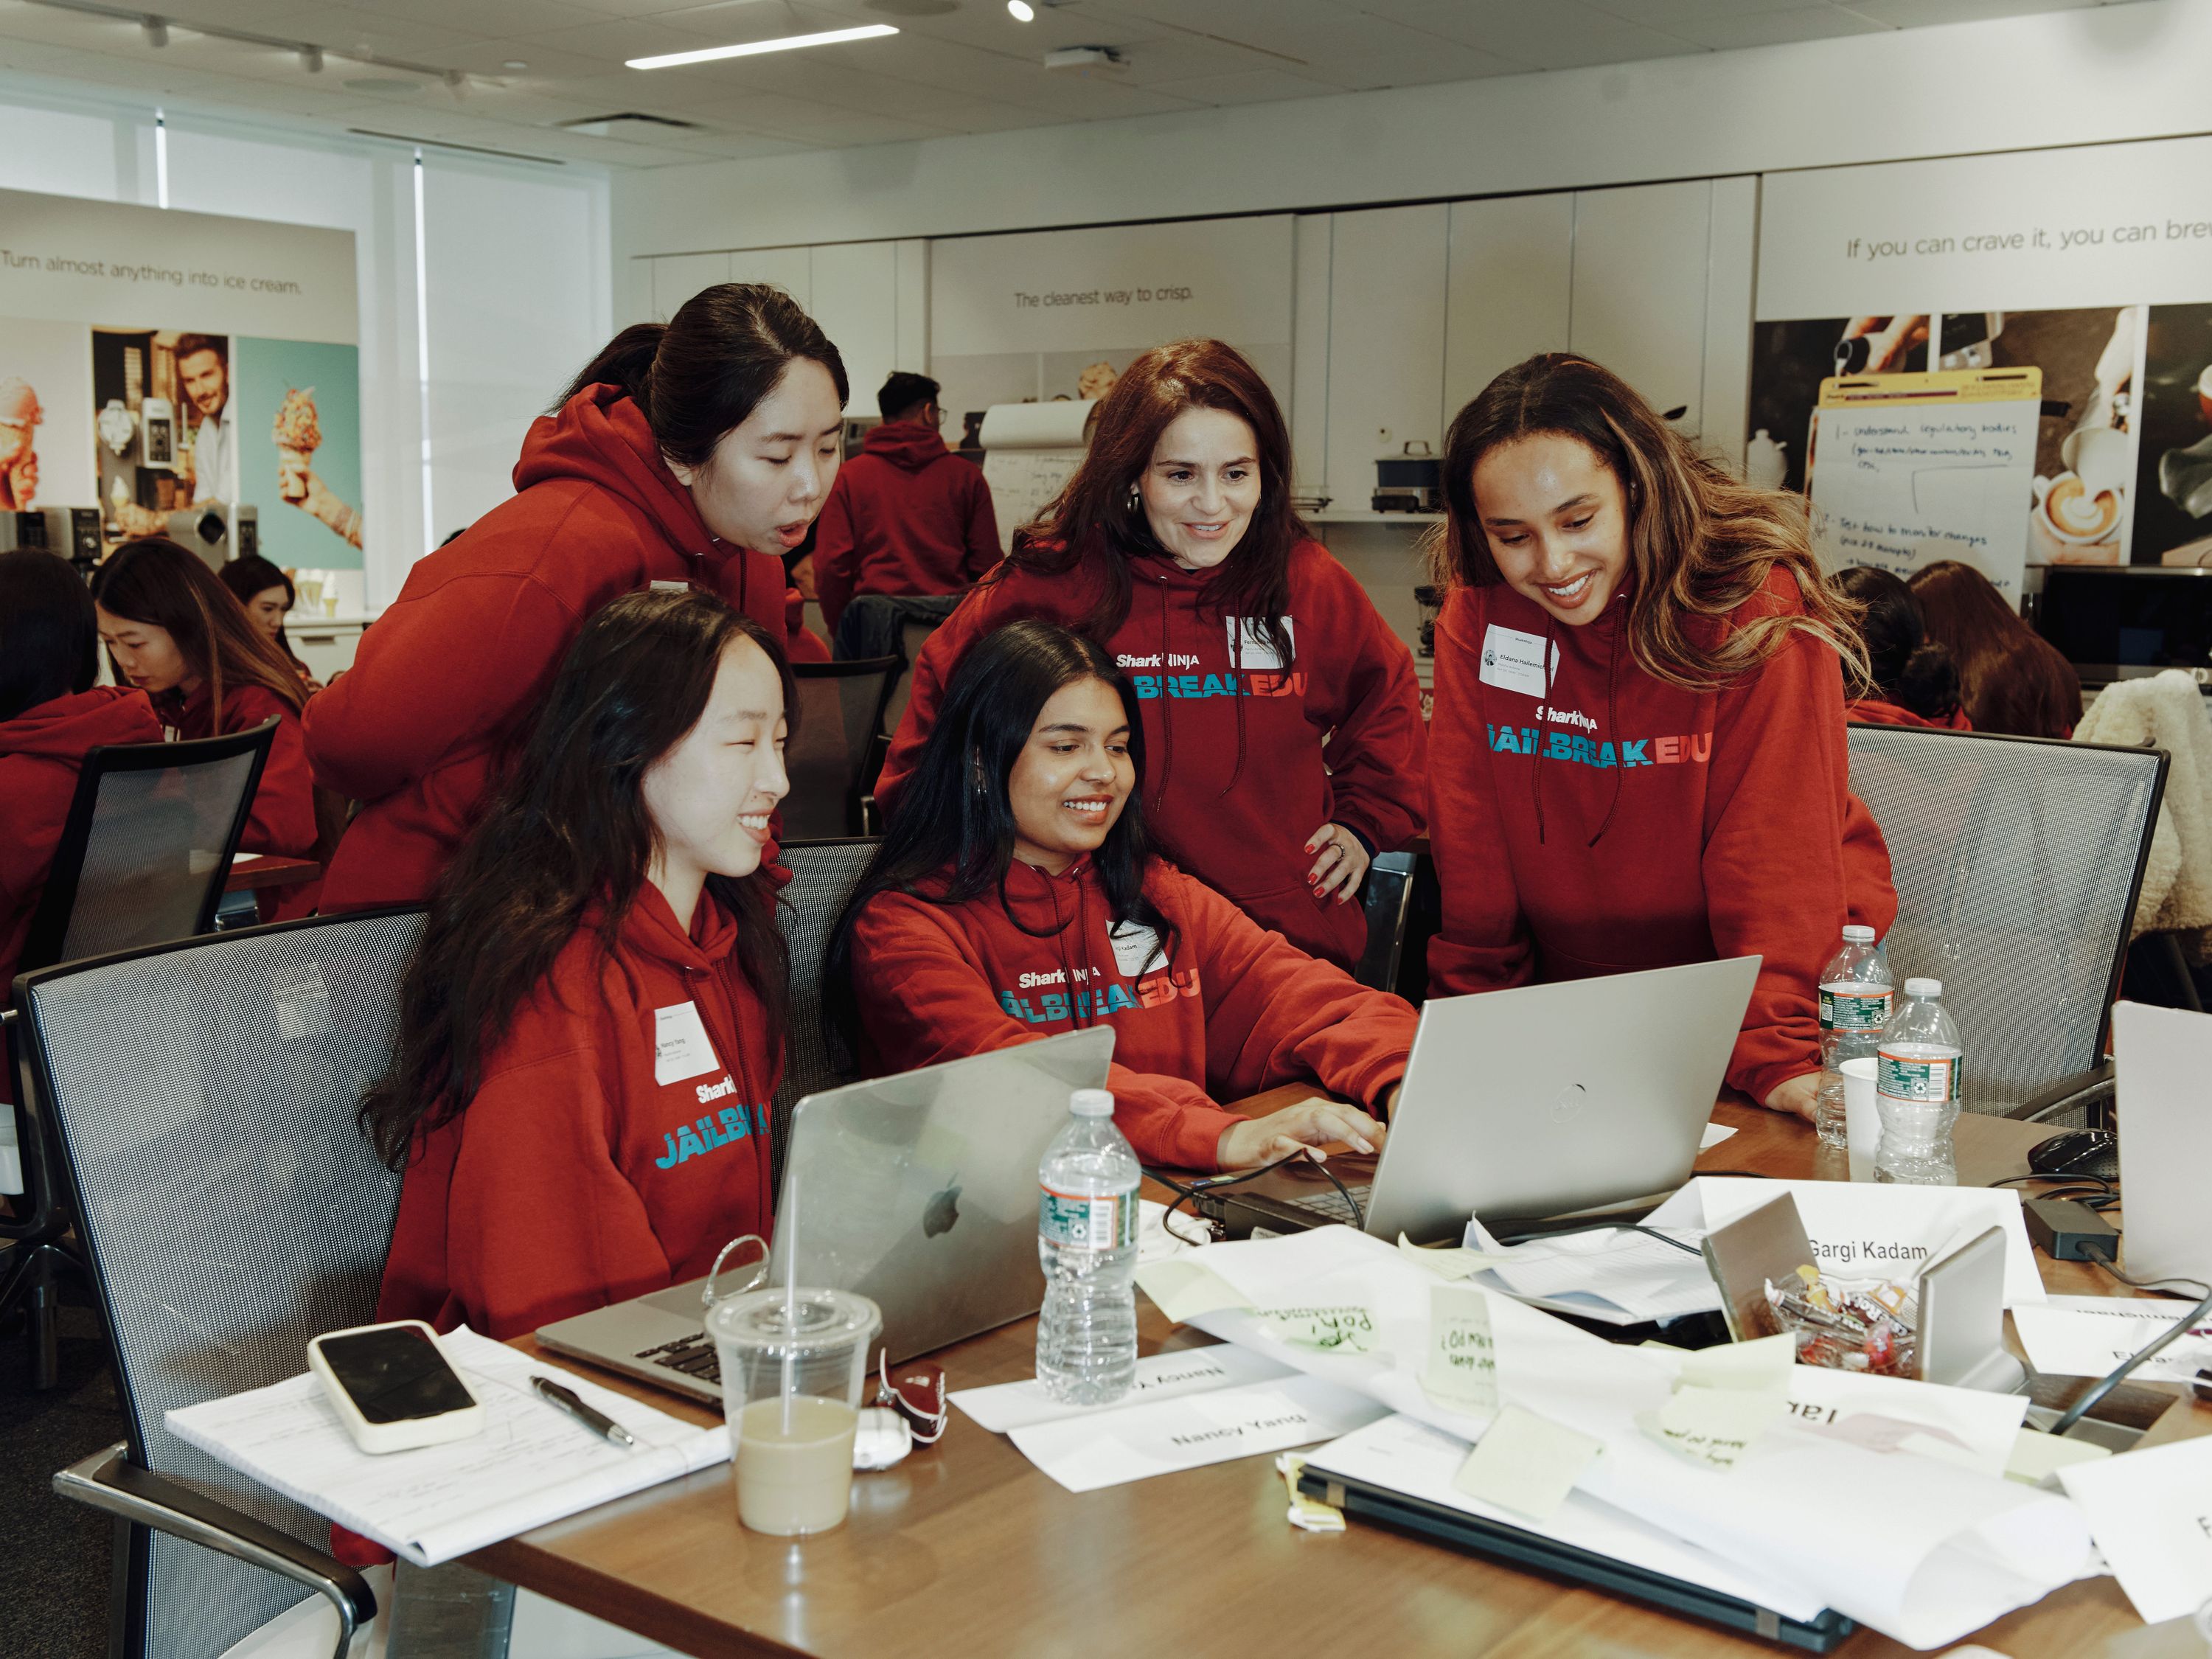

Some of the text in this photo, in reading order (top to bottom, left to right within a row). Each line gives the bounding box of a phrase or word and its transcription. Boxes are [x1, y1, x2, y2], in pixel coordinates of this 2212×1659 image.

[1847, 237, 1861, 258] If
[1868, 240, 1907, 261] you
[1916, 237, 1955, 255] can
[1962, 232, 2025, 252] crave
[2032, 227, 2051, 249] it,
[2059, 228, 2104, 251] you
[2112, 224, 2157, 243] can
[1, 248, 302, 295] Turn almost anything into ice cream.
[1015, 292, 1039, 308] The
[1043, 289, 1100, 307] cleanest
[1104, 290, 1133, 305] way
[1136, 287, 1152, 302] to
[1808, 1239, 1928, 1263] Gargi Kadam
[1170, 1413, 1308, 1447] Nancy Yang
